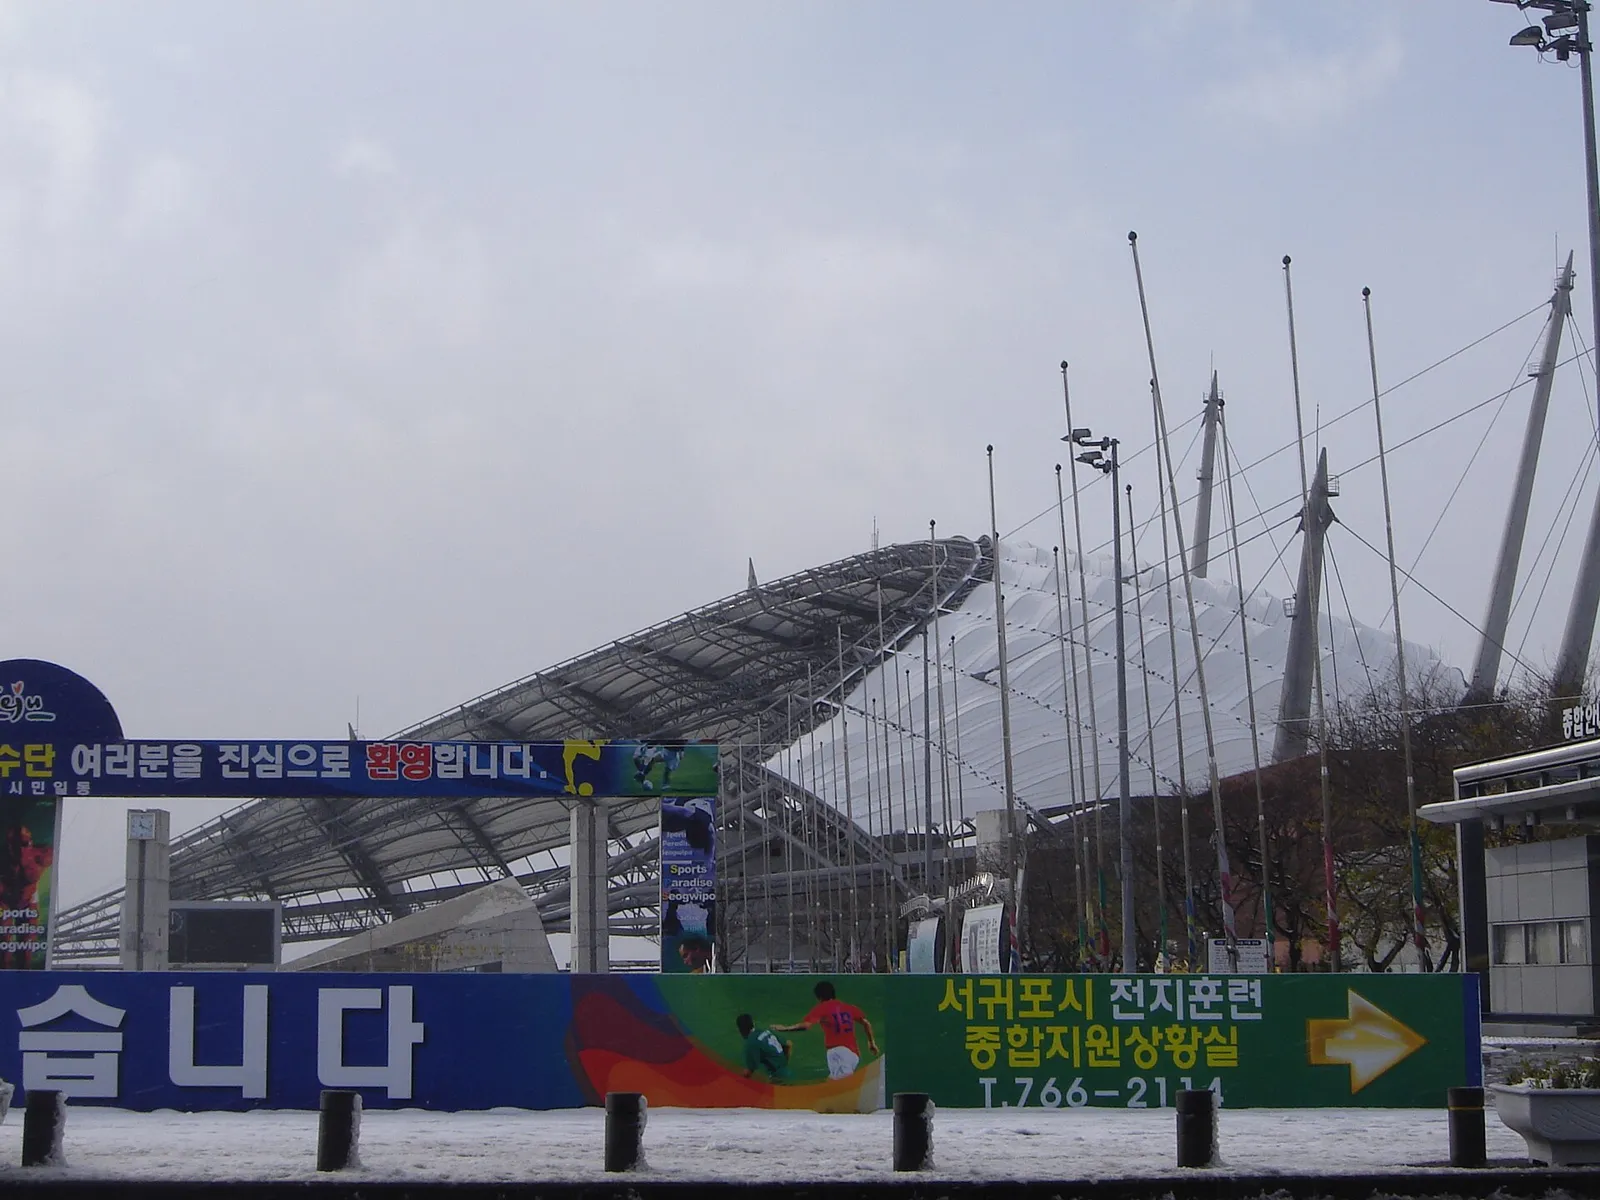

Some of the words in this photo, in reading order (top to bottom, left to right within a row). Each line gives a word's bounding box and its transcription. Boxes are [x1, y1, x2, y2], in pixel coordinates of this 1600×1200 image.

[71, 743, 202, 779] 여러분을
[217, 744, 350, 778] 진심으로
[365, 742, 547, 780] 환영합니다.
[664, 878, 712, 887] Paradise
[670, 864, 707, 876] Sports
[663, 892, 716, 903] Seogwipo
[938, 978, 1093, 1020] 서귀포시
[1109, 977, 1263, 1020] 전지훈련
[17, 985, 424, 1099] 습니다
[965, 1024, 1239, 1070] 종합지원상황실
